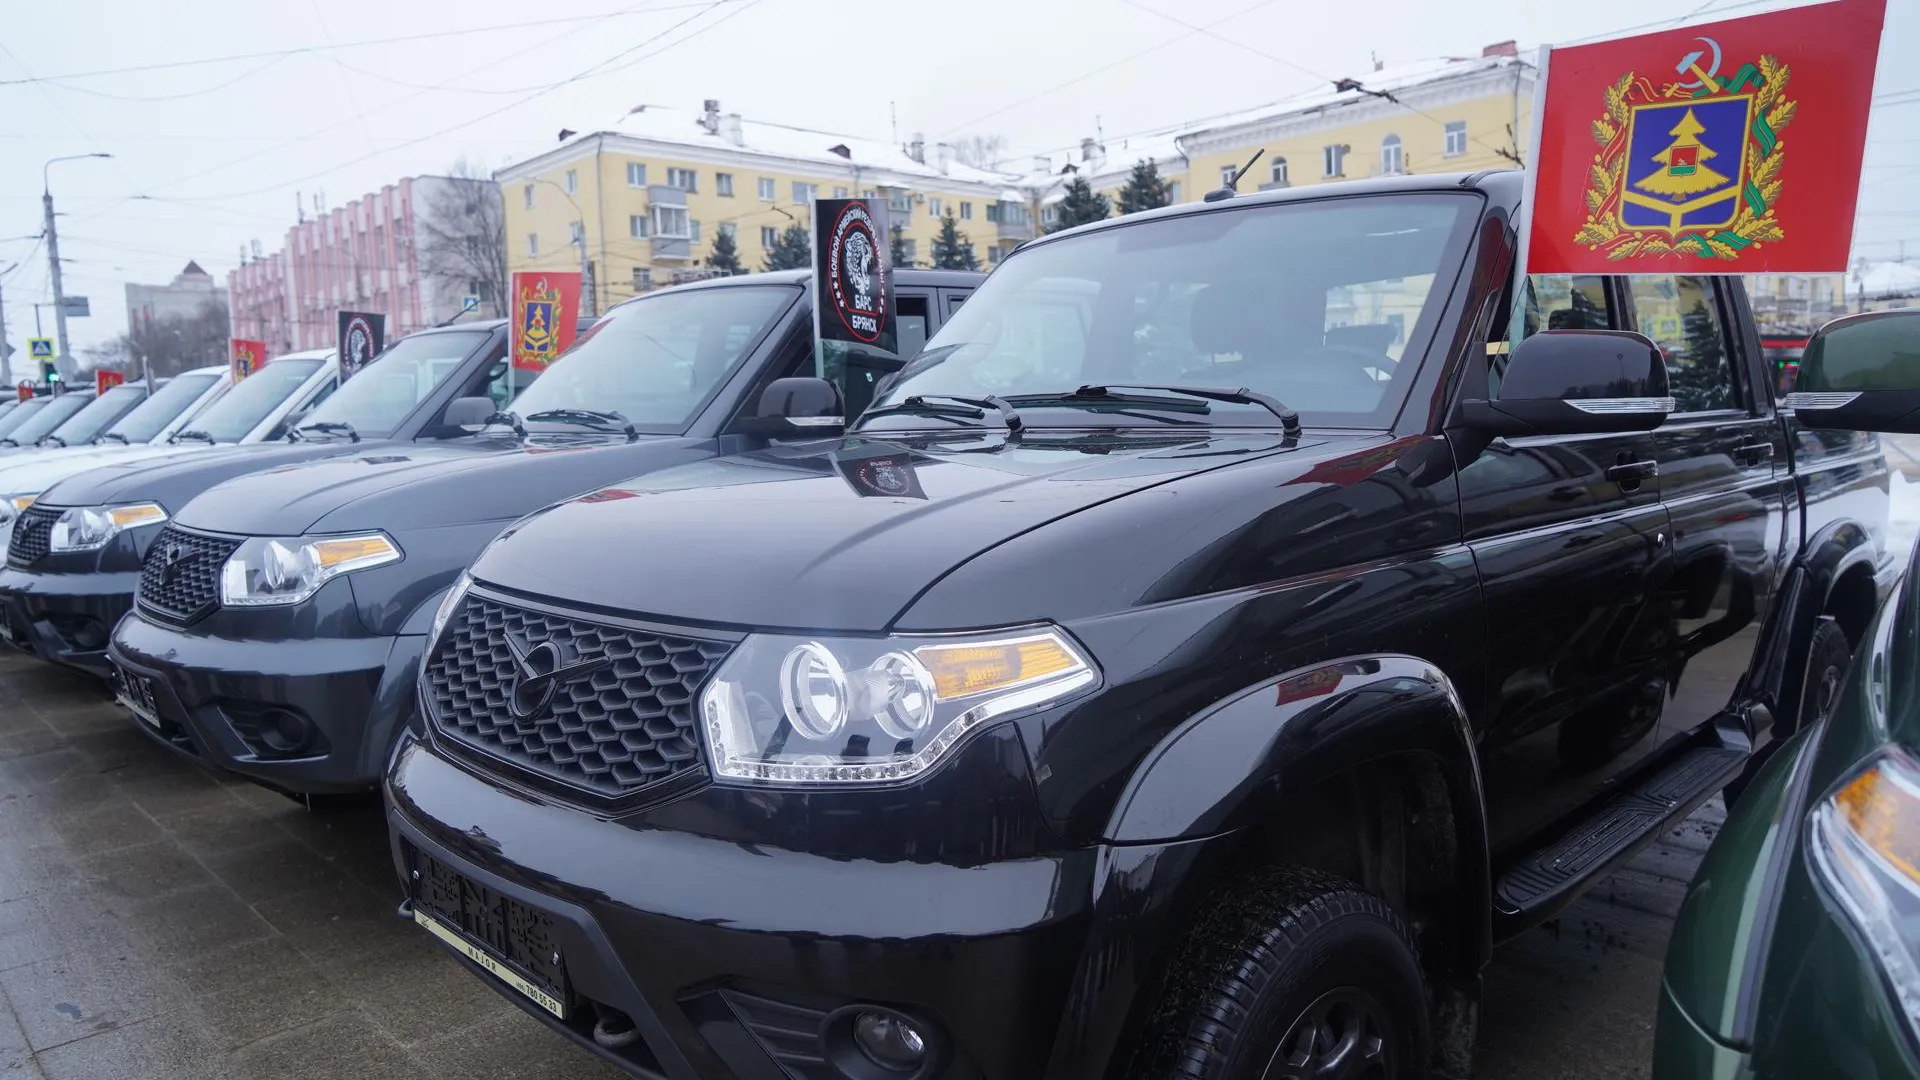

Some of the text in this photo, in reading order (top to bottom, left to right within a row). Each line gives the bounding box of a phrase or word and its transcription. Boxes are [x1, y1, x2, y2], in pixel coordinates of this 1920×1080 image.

[831, 235, 840, 278] БОЕВОЙ
[854, 294, 872, 311] БАРС
[852, 315, 877, 333] БРЯНСК
[468, 947, 496, 972] MAJOR
[526, 985, 538, 1000] 780
[548, 1000, 557, 1012] 33
